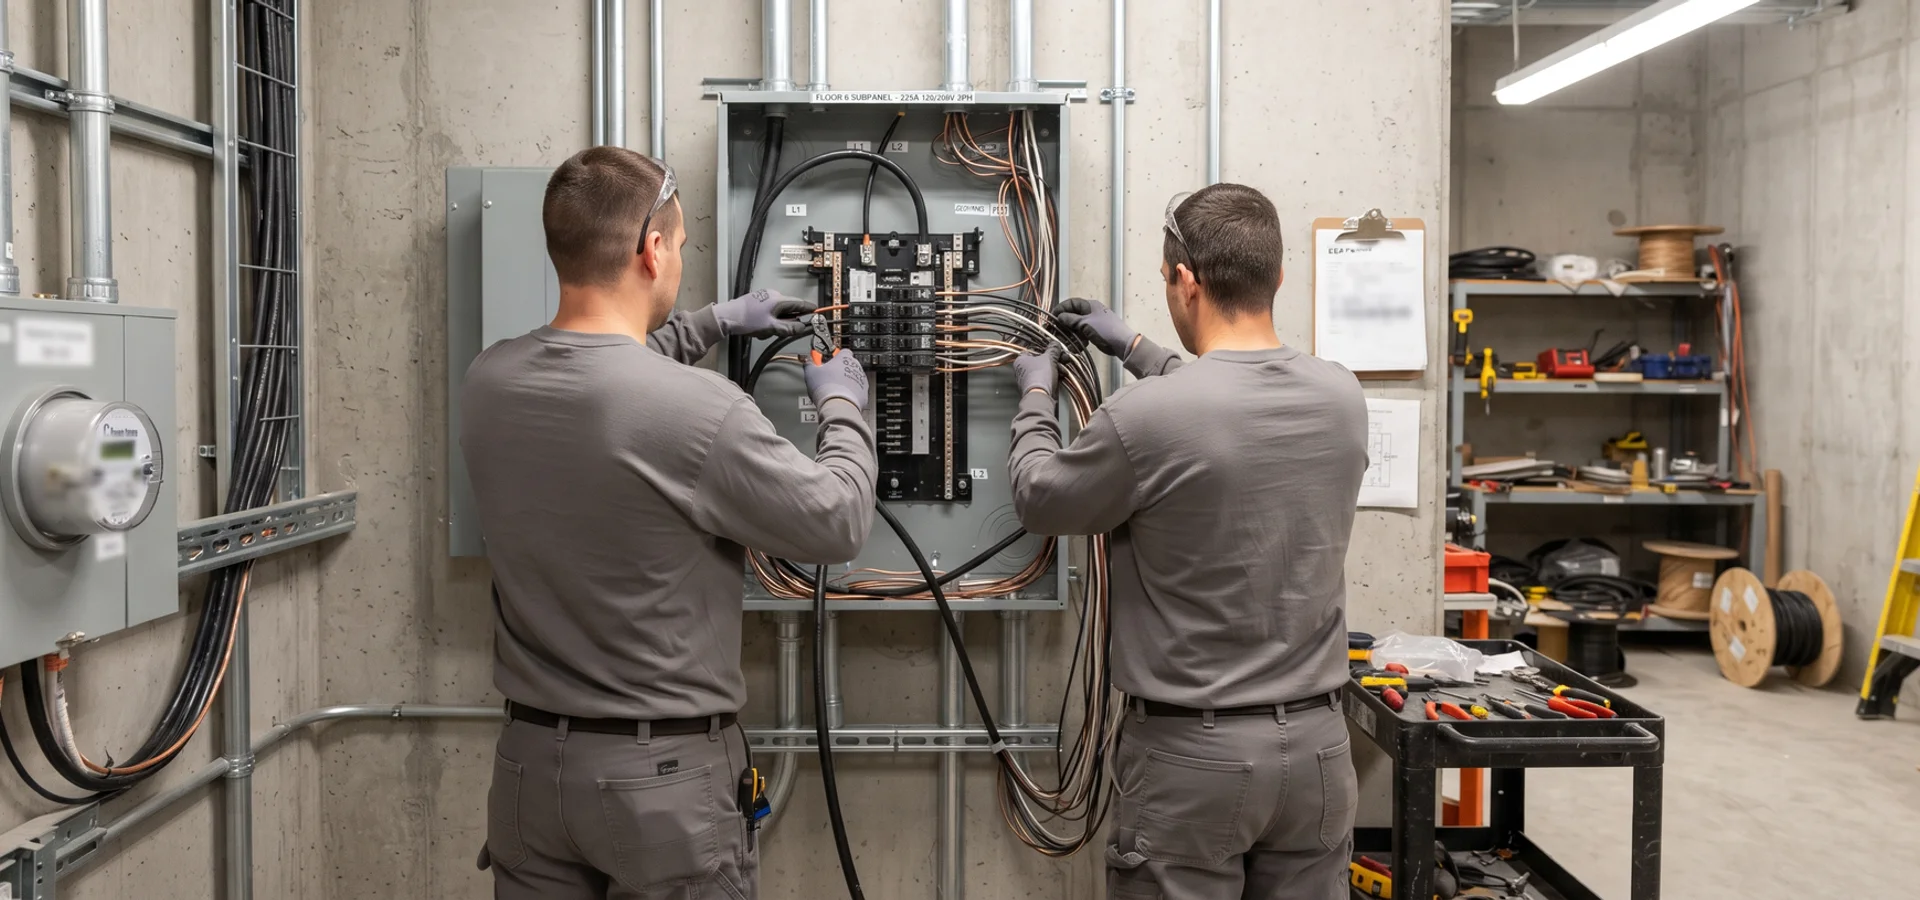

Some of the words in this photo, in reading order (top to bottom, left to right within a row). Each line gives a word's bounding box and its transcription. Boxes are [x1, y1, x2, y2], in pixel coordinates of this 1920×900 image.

[816, 93, 843, 101] FLOOR
[844, 93, 849, 101] 6
[850, 93, 893, 101] SUBPANEL
[900, 93, 919, 101] 225A
[892, 142, 902, 151] L2
[804, 413, 815, 421] L2
[973, 470, 985, 478] L2
